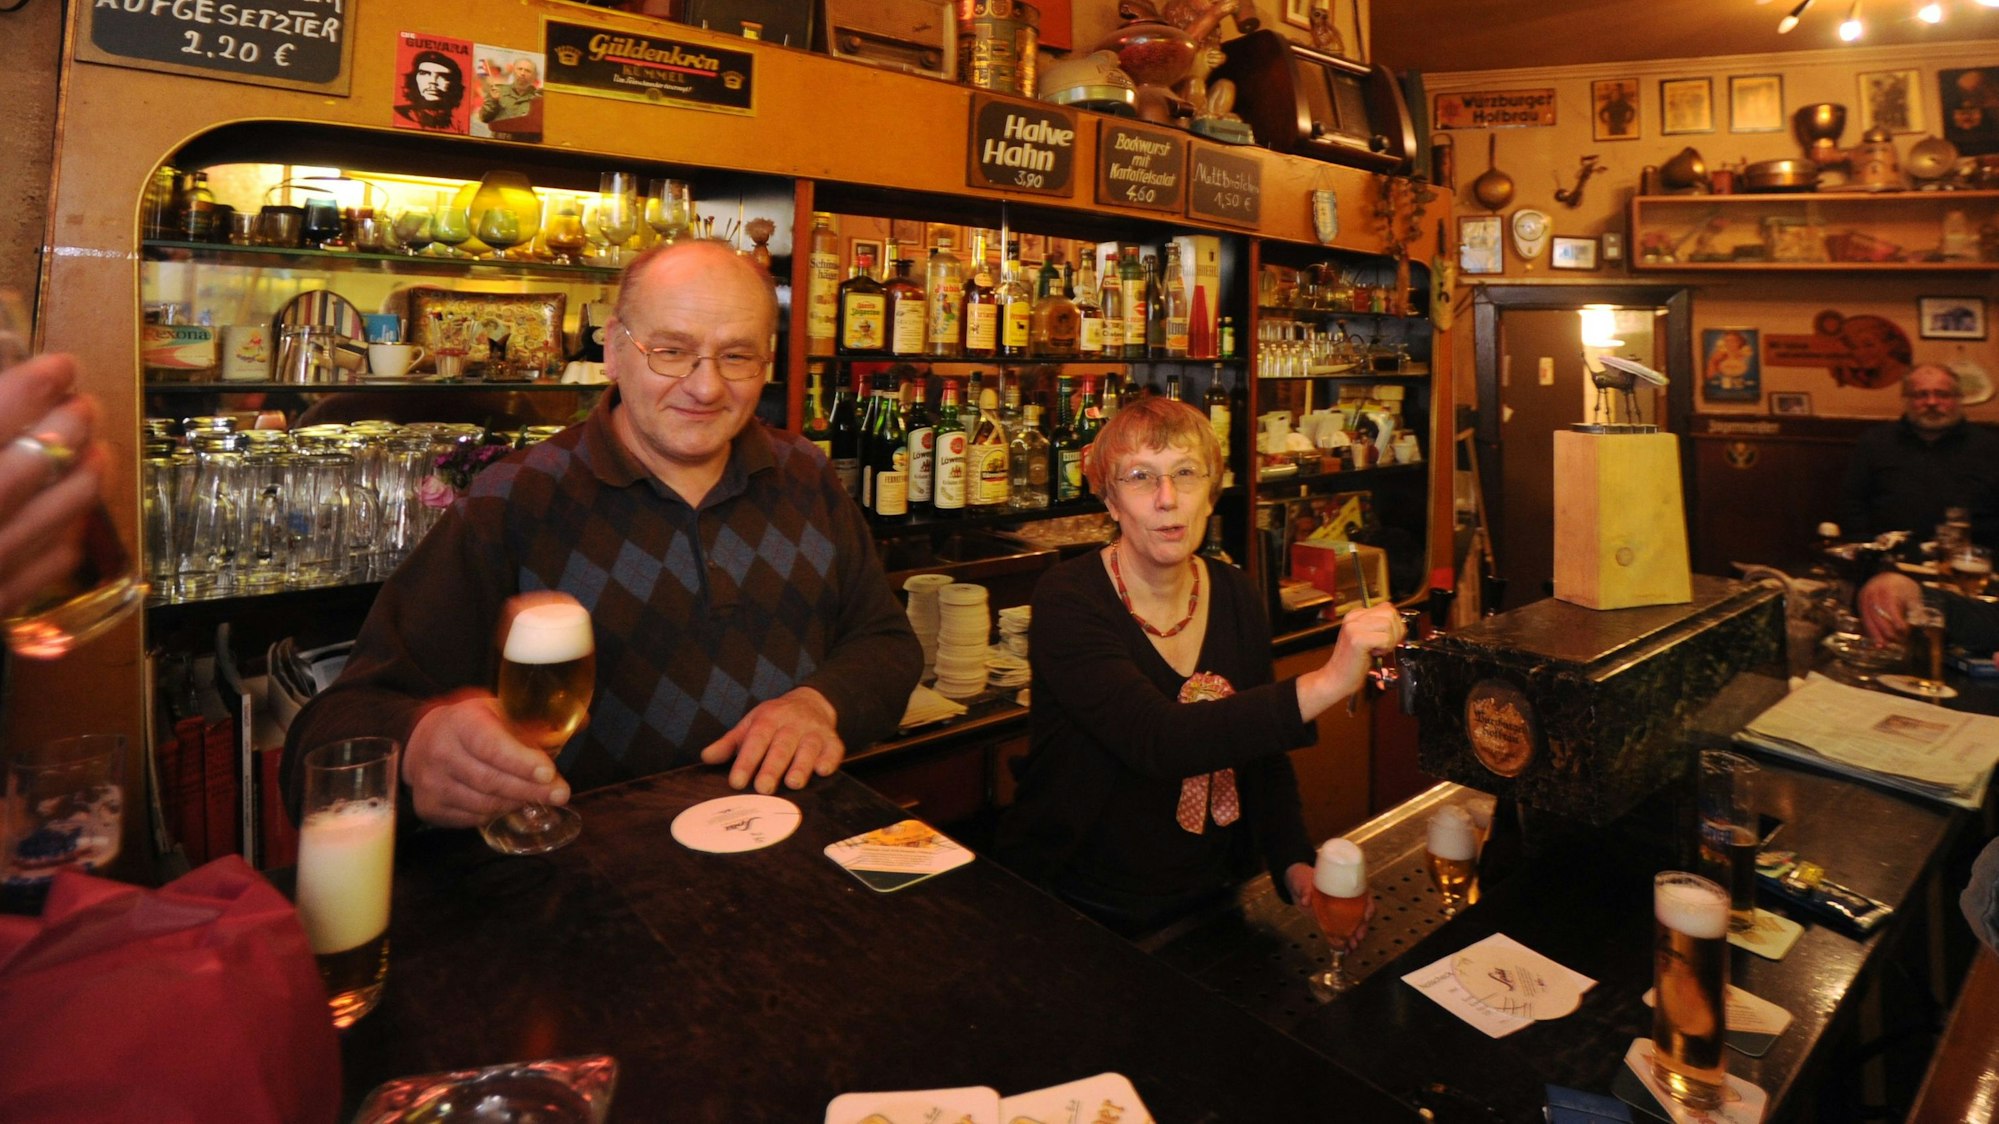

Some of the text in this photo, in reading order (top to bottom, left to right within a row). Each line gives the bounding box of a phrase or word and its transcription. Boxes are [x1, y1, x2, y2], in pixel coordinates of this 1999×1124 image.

[181, 30, 296, 67] 2.20 €
[405, 38, 469, 56] GUEVARA
[1003, 114, 1074, 147] Halve
[982, 138, 1056, 172] Hahn
[1114, 132, 1171, 156] Bockwurst
[1131, 153, 1151, 168] mit
[1013, 170, 1044, 189] 3,90
[1109, 162, 1176, 187] Kartoffelsalat
[1126, 184, 1156, 203] 4,60
[1214, 191, 1253, 212] 1,50 €
